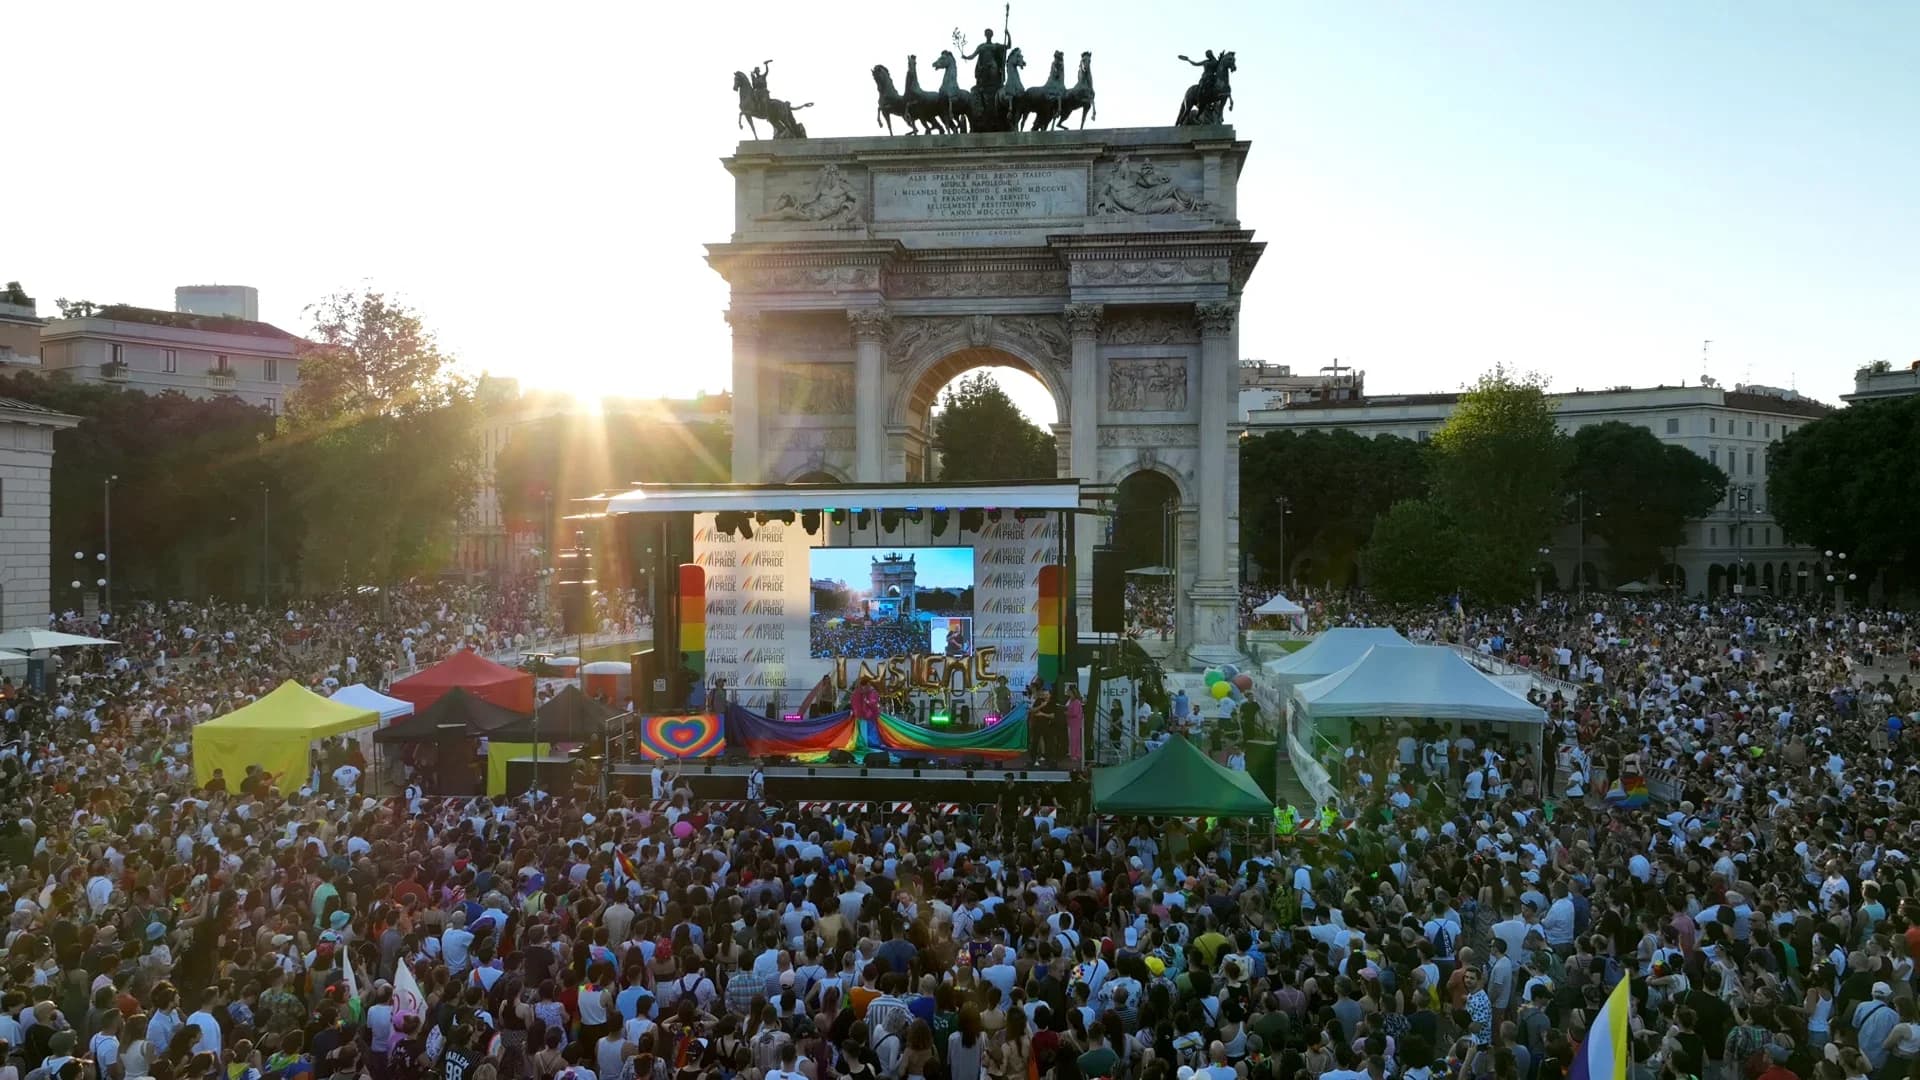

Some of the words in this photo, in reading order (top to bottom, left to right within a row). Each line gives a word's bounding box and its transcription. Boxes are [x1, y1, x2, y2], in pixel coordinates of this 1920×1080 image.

[714, 533, 736, 543] PRIDE
[762, 533, 784, 543] PRIDE
[1002, 530, 1025, 540] PRIDE
[715, 557, 736, 567] PRIDE
[762, 557, 784, 567] PRIDE
[1002, 555, 1025, 564] PRIDE
[715, 582, 736, 592] PRIDE
[762, 582, 785, 592] PRIDE
[1003, 580, 1025, 589] PRIDE
[716, 606, 737, 616] PRIDE
[763, 606, 785, 616] PRIDE
[1003, 604, 1025, 614] PRIDE
[716, 631, 737, 640] PRIDE
[763, 631, 785, 640] PRIDE
[1003, 629, 1025, 638] PRIDE
[717, 655, 738, 664] PRIDE
[763, 655, 785, 664] PRIDE
[1003, 653, 1025, 663] PRIDE
[834, 646, 997, 696] INSIEME
[765, 679, 787, 688] PRIDE
[1103, 687, 1128, 696] HELP
